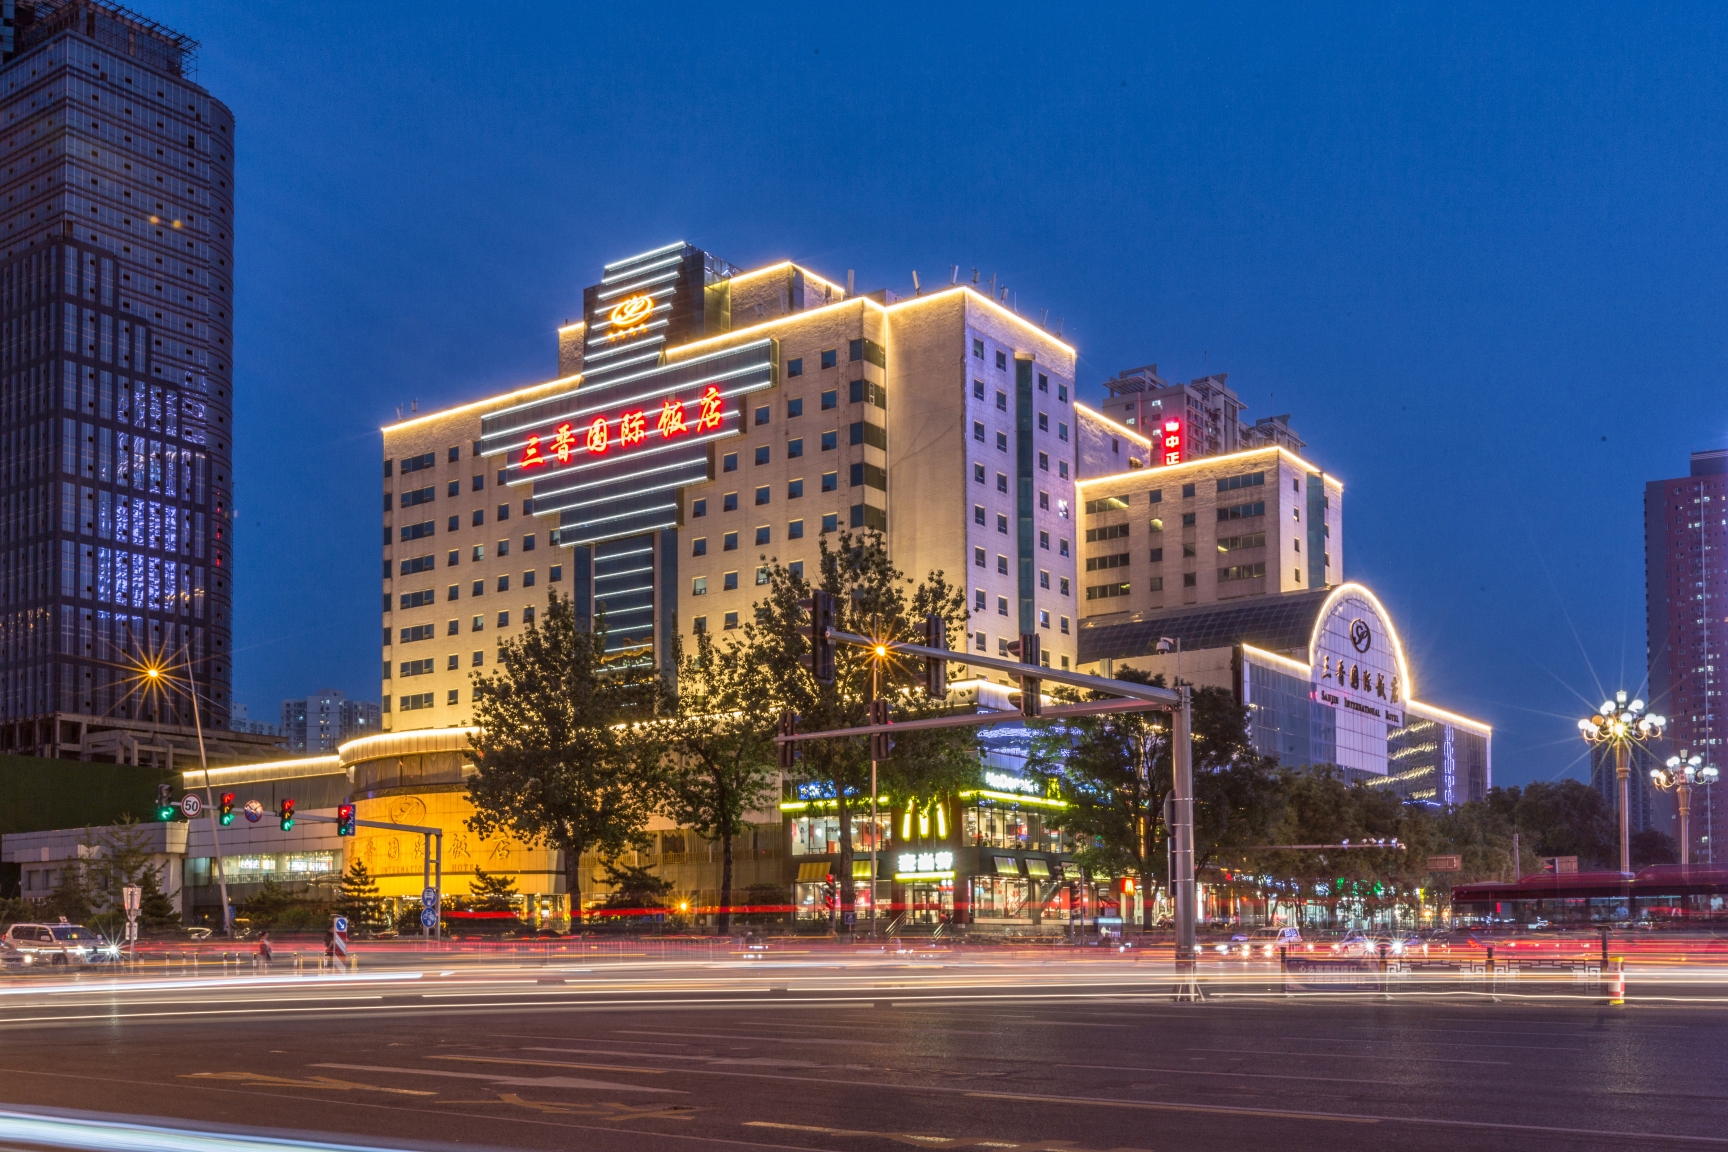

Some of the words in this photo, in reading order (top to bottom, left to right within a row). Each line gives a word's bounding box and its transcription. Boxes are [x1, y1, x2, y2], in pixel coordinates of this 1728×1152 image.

[521, 387, 723, 467] 三晋国际饭店
[1321, 655, 1399, 704] 三晋国际饭店
[185, 800, 198, 812] 50
[451, 863, 477, 872] HOTE
